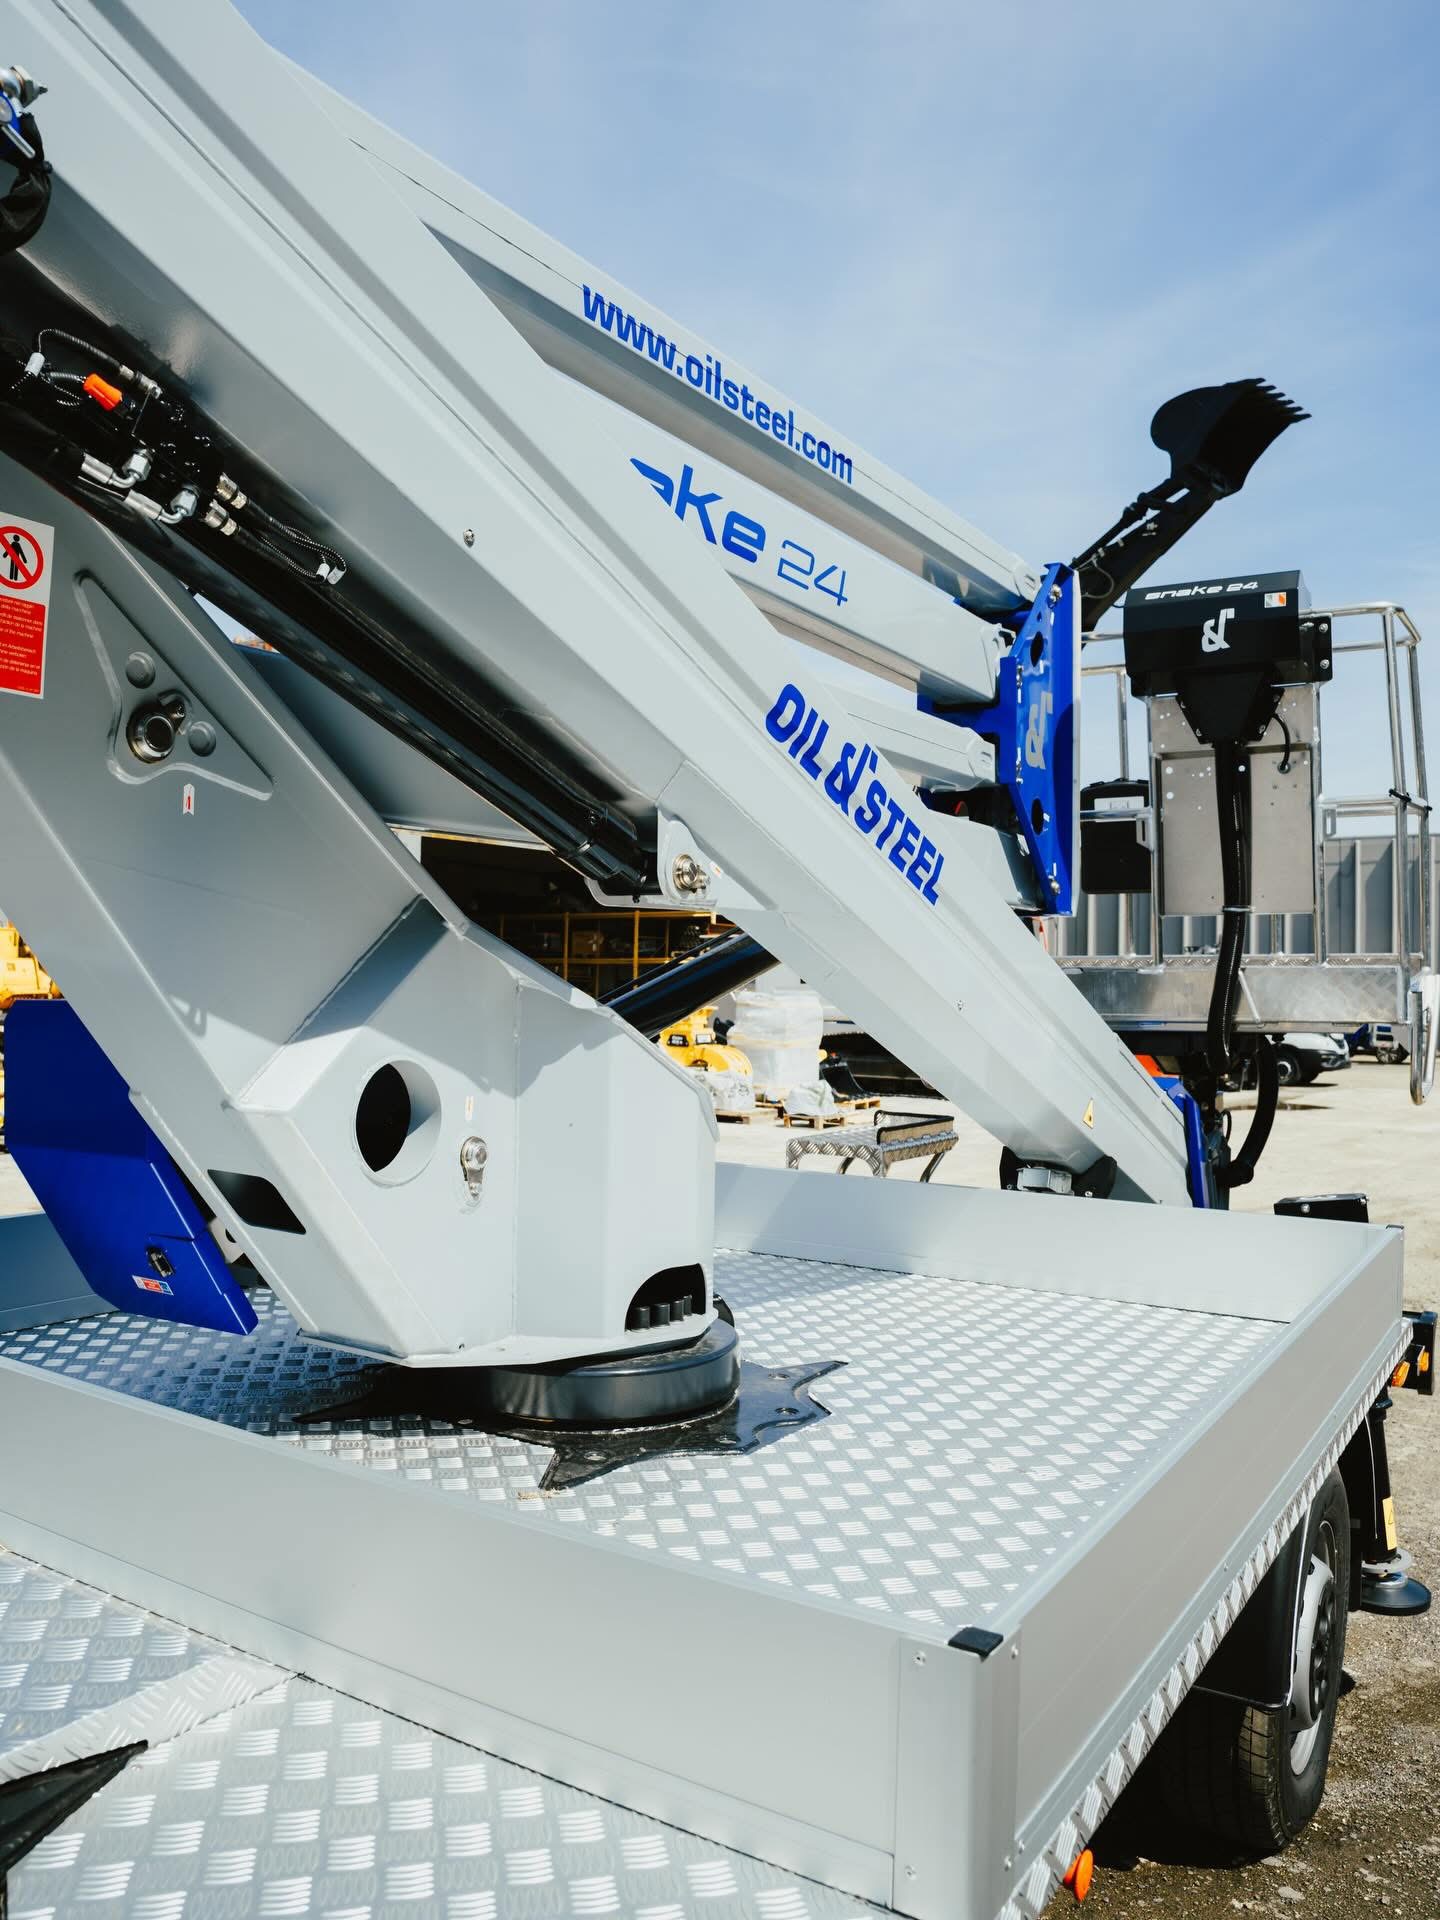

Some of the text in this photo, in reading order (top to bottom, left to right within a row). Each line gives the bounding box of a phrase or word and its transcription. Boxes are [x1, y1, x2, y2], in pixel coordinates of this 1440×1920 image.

[583, 284, 853, 484] www.oilsteel.com
[777, 539, 848, 607] 24
[1144, 581, 1260, 600] snake 24
